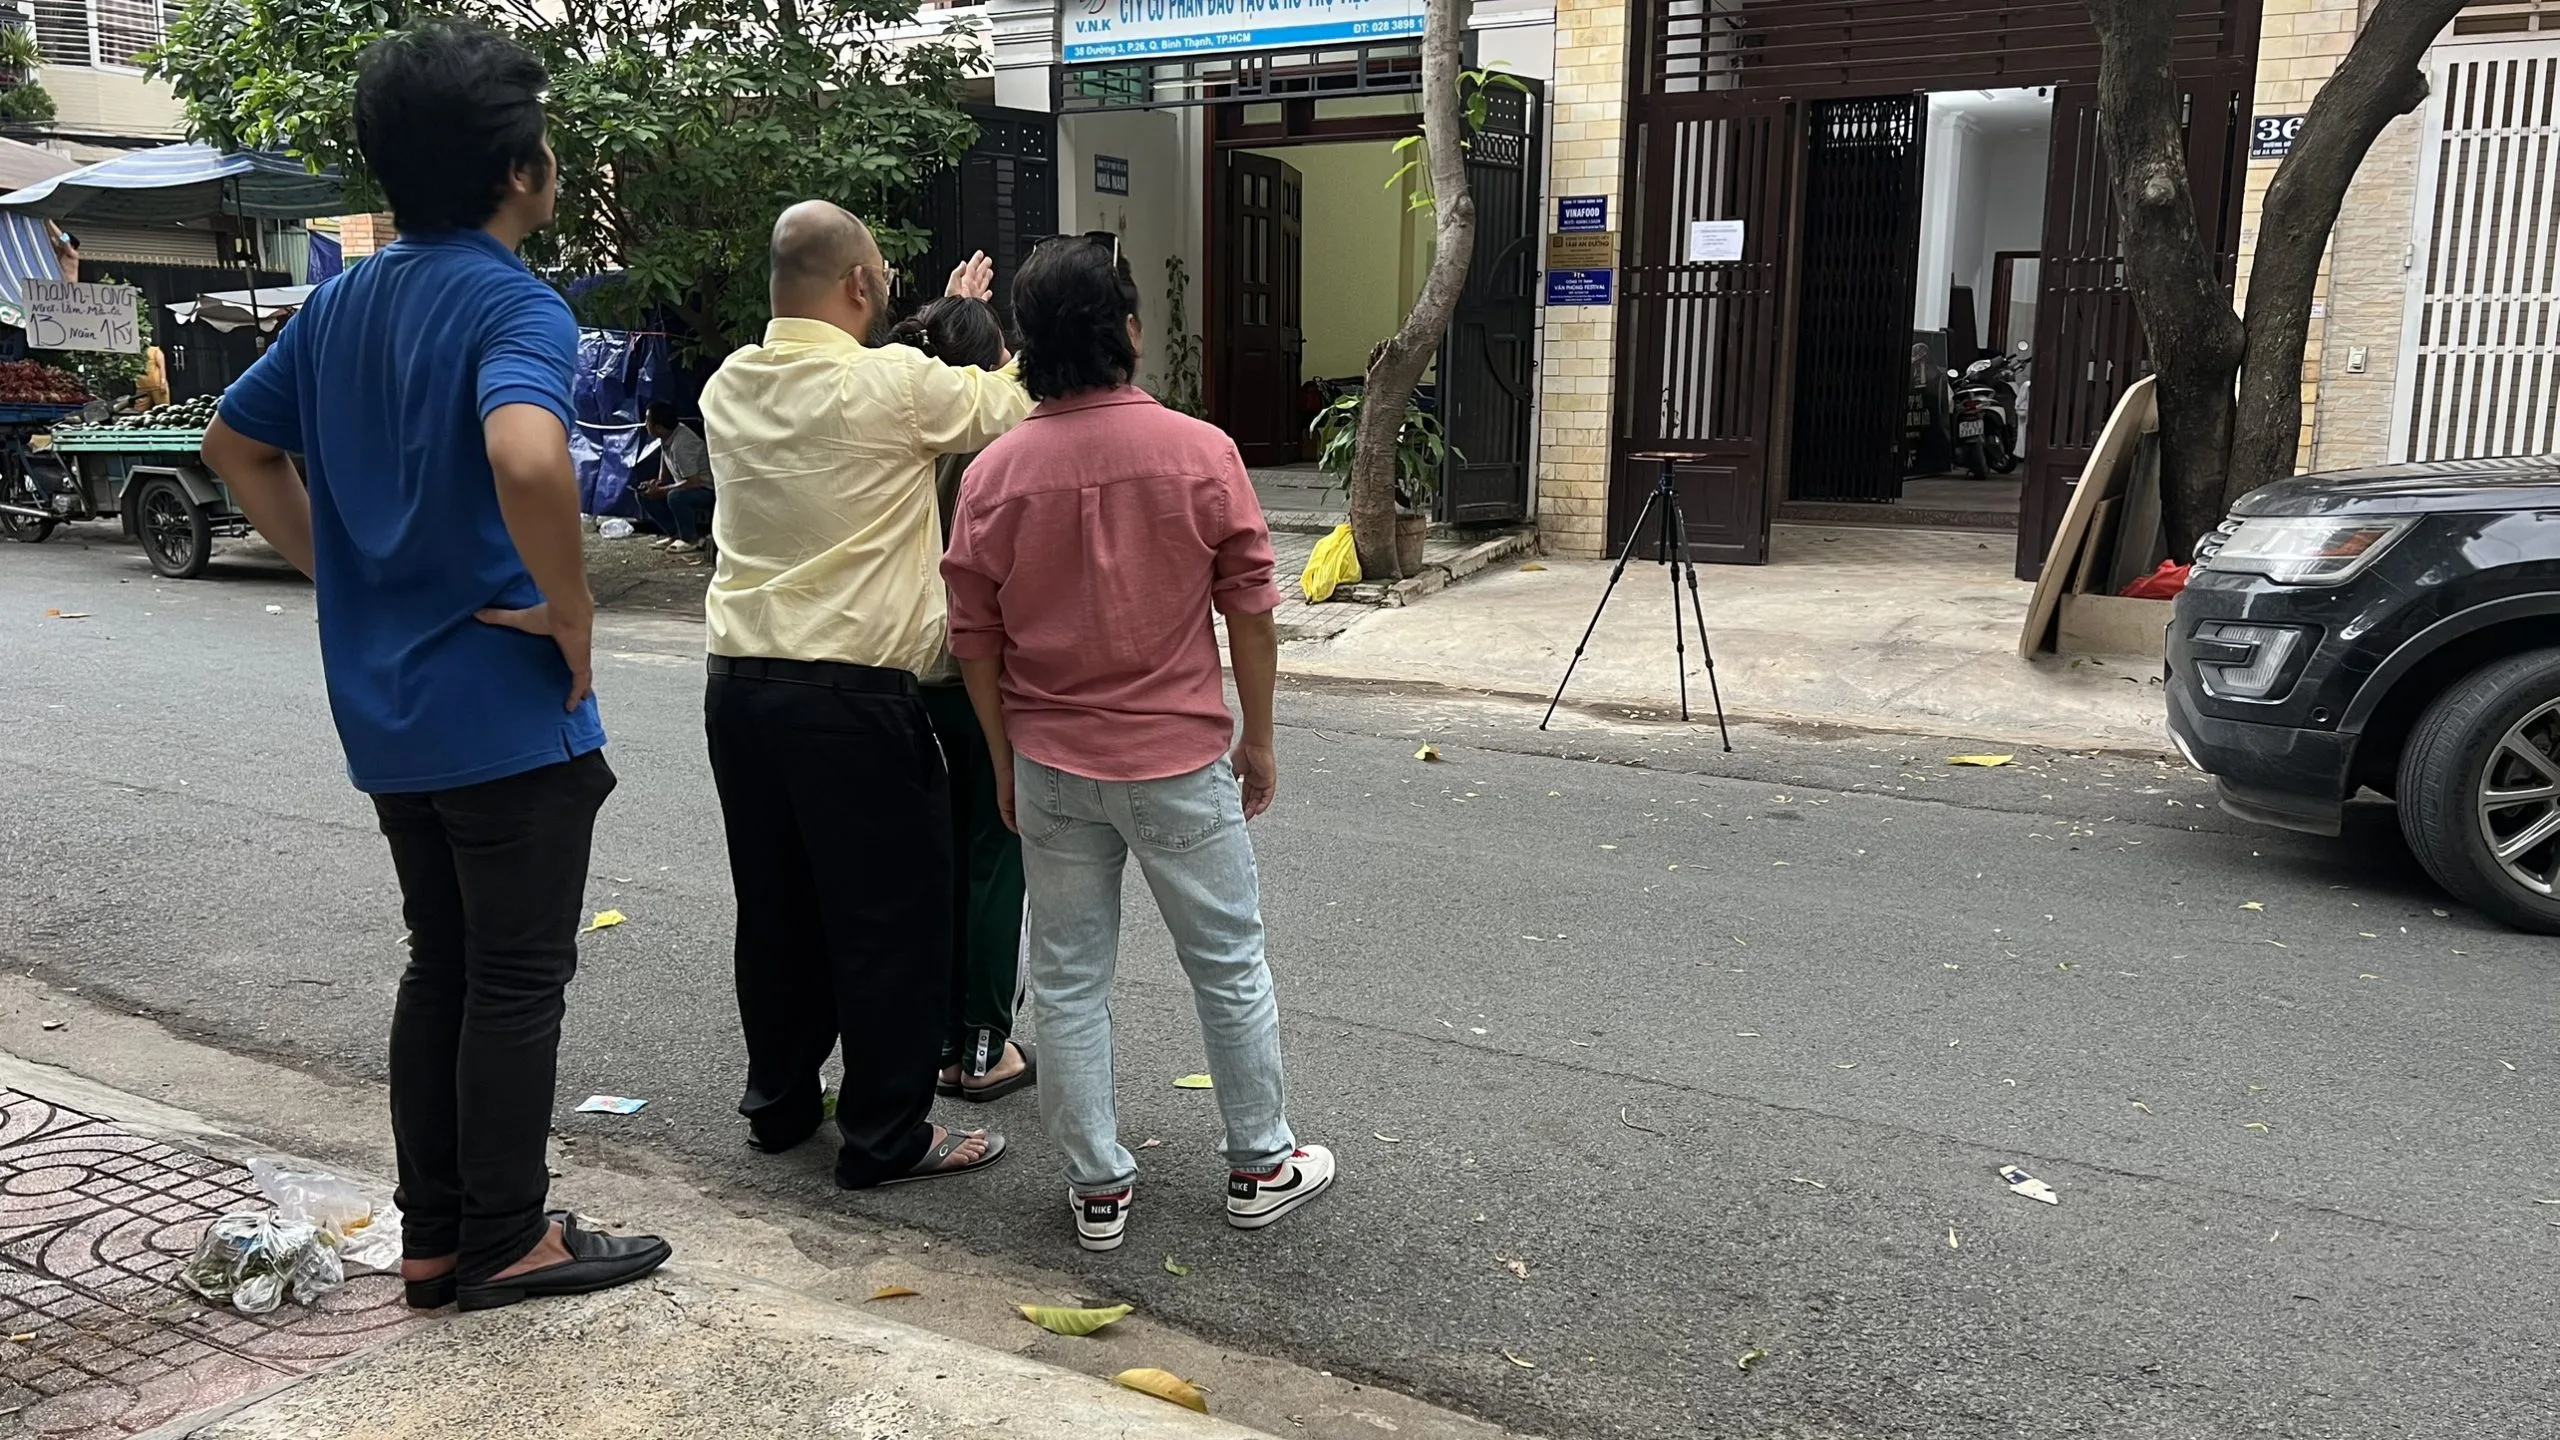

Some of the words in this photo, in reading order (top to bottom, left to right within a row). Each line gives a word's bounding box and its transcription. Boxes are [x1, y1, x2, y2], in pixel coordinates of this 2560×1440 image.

[1075, 18, 1111, 33] V.N.K
[1372, 21, 1389, 32] 028
[1074, 46, 1084, 56] 38
[2256, 117, 2305, 141] 36
[1565, 207, 1600, 218] VINAFOOD
[30, 313, 66, 347] 13
[1231, 1180, 1249, 1192] NIKE
[1091, 1204, 1112, 1215] NIKE
